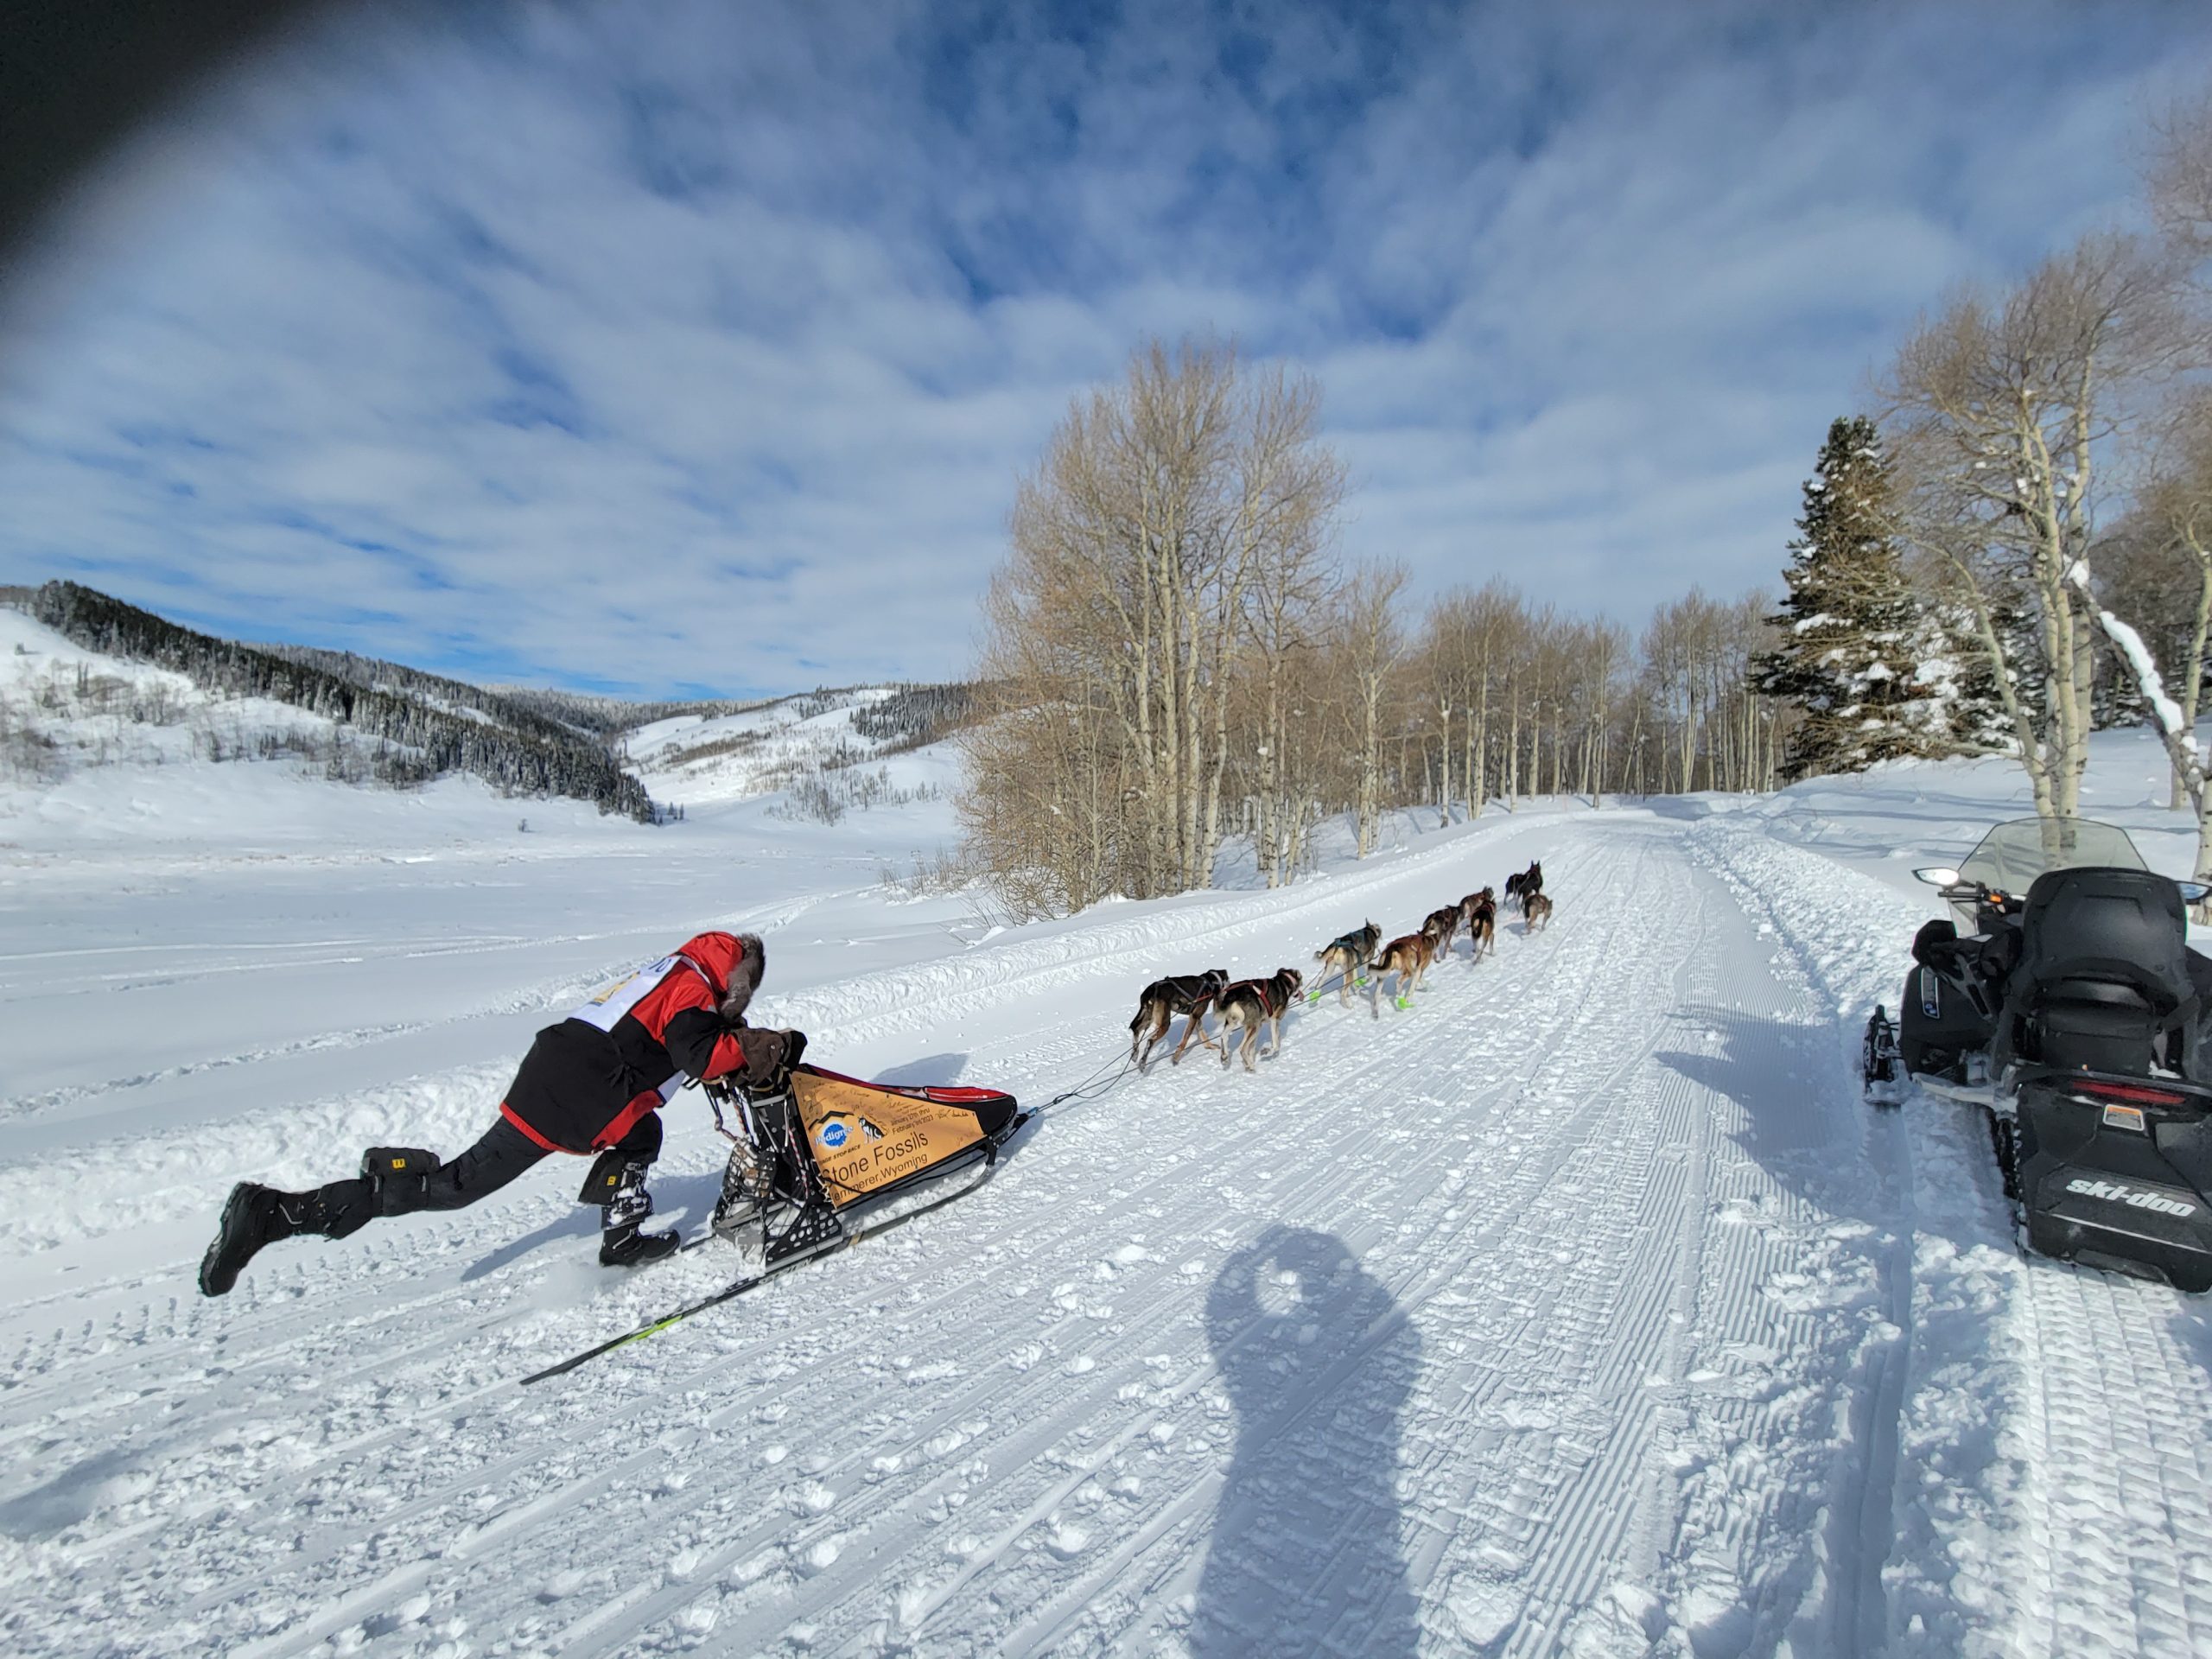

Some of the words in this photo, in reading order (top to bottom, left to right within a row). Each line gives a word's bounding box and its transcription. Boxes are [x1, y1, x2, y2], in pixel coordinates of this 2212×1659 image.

[815, 1126, 854, 1148] Pedigree
[892, 1122, 914, 1135] February
[833, 1150, 847, 1160] STOP
[874, 1132, 929, 1166] Fossils
[831, 1173, 882, 1201] emmerer,
[880, 1153, 928, 1178] Wyoming
[2065, 1179, 2197, 1217] ski-doo
